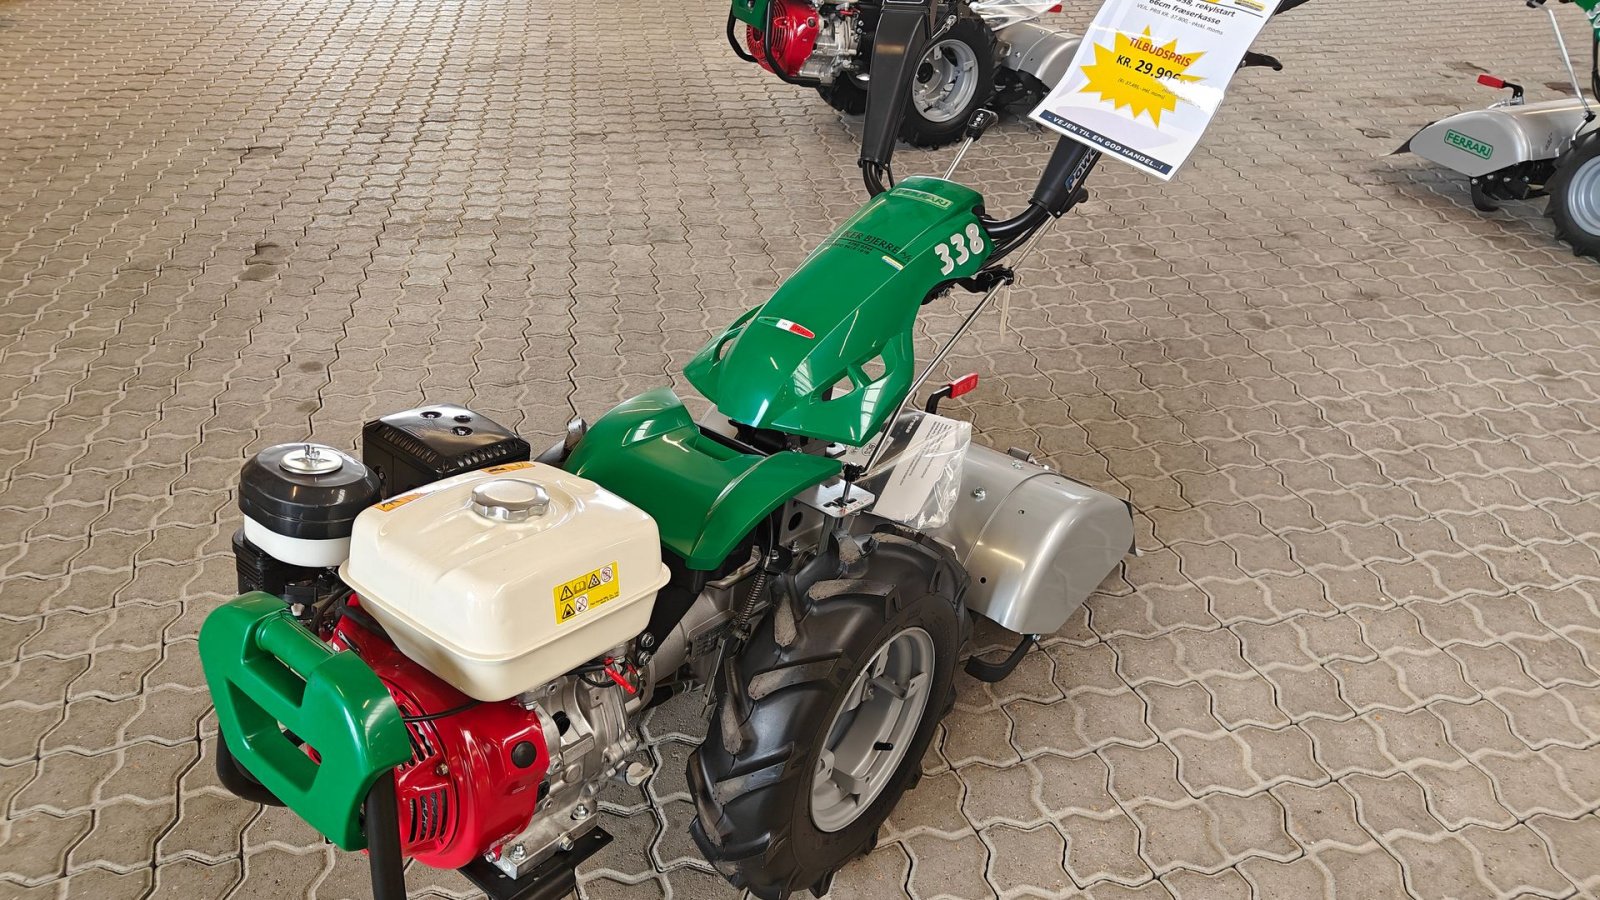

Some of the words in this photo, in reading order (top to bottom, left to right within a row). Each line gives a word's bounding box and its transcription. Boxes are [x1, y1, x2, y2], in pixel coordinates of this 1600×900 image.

[1172, 5, 1221, 25] fræserkasse
[1195, 2, 1236, 18] rekylstart
[1116, 54, 1132, 69] KR.
[1129, 37, 1192, 67] TILBUDSPRIS
[1053, 116, 1078, 132] VEJEN
[1079, 128, 1091, 139] TIL
[1092, 134, 1104, 144] EN
[1104, 140, 1122, 152] GOD
[1446, 132, 1491, 157] FERRARI
[934, 223, 984, 276] 338
